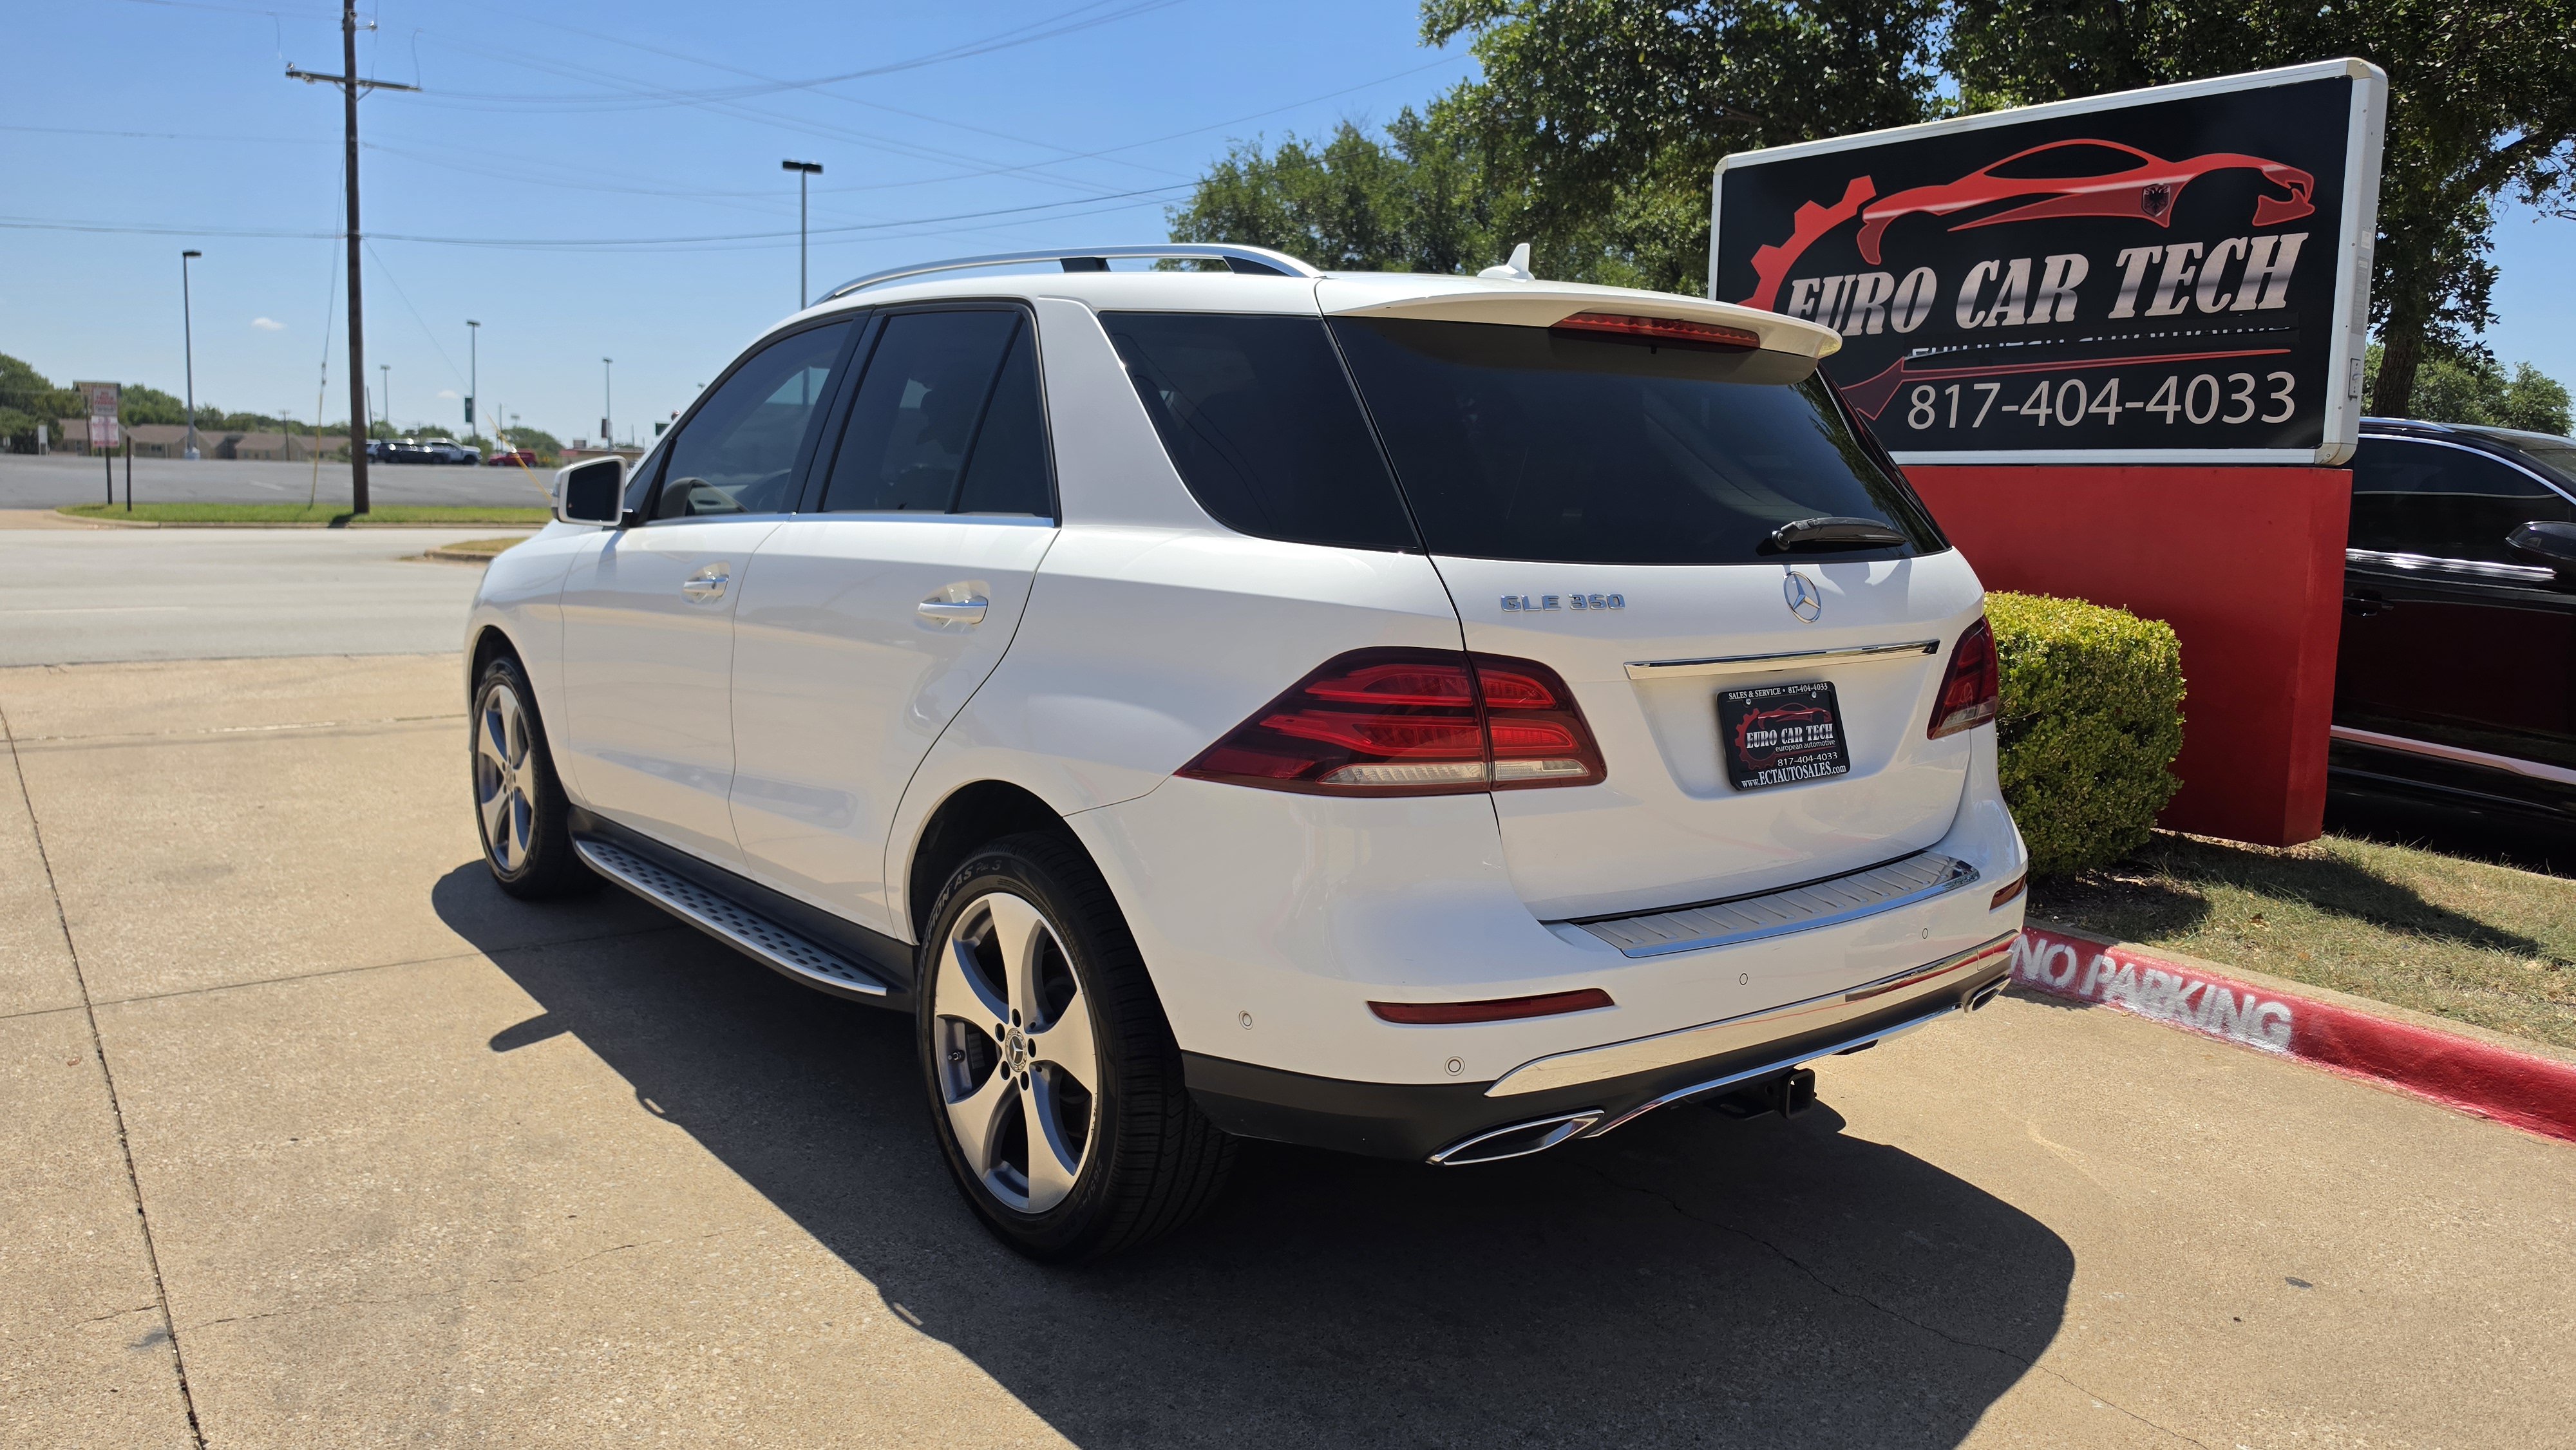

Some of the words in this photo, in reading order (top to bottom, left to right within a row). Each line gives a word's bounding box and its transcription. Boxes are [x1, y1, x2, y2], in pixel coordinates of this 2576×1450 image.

[1787, 266, 1938, 337] EURO
[1955, 252, 2089, 330] CAR
[2108, 232, 2309, 319] TECH
[1908, 371, 2296, 431] 817-404-4033
[1501, 594, 1561, 612] GLE
[1569, 593, 1625, 610] 350
[1728, 692, 1747, 700] SALES
[1754, 688, 1781, 697] SERVICE
[1788, 683, 1828, 694] 817-404-4033
[1746, 730, 1777, 749] EURO
[1781, 726, 1803, 744] CAR
[1806, 723, 1833, 742] TECH
[1775, 743, 1803, 753] european
[1803, 739, 1835, 749] automotive
[1777, 751, 1838, 767] 817-404-4033
[1741, 761, 1847, 788] www.ECTAUTOSALES.com
[2010, 933, 2078, 988] NO
[2079, 954, 2293, 1053] PARKING
